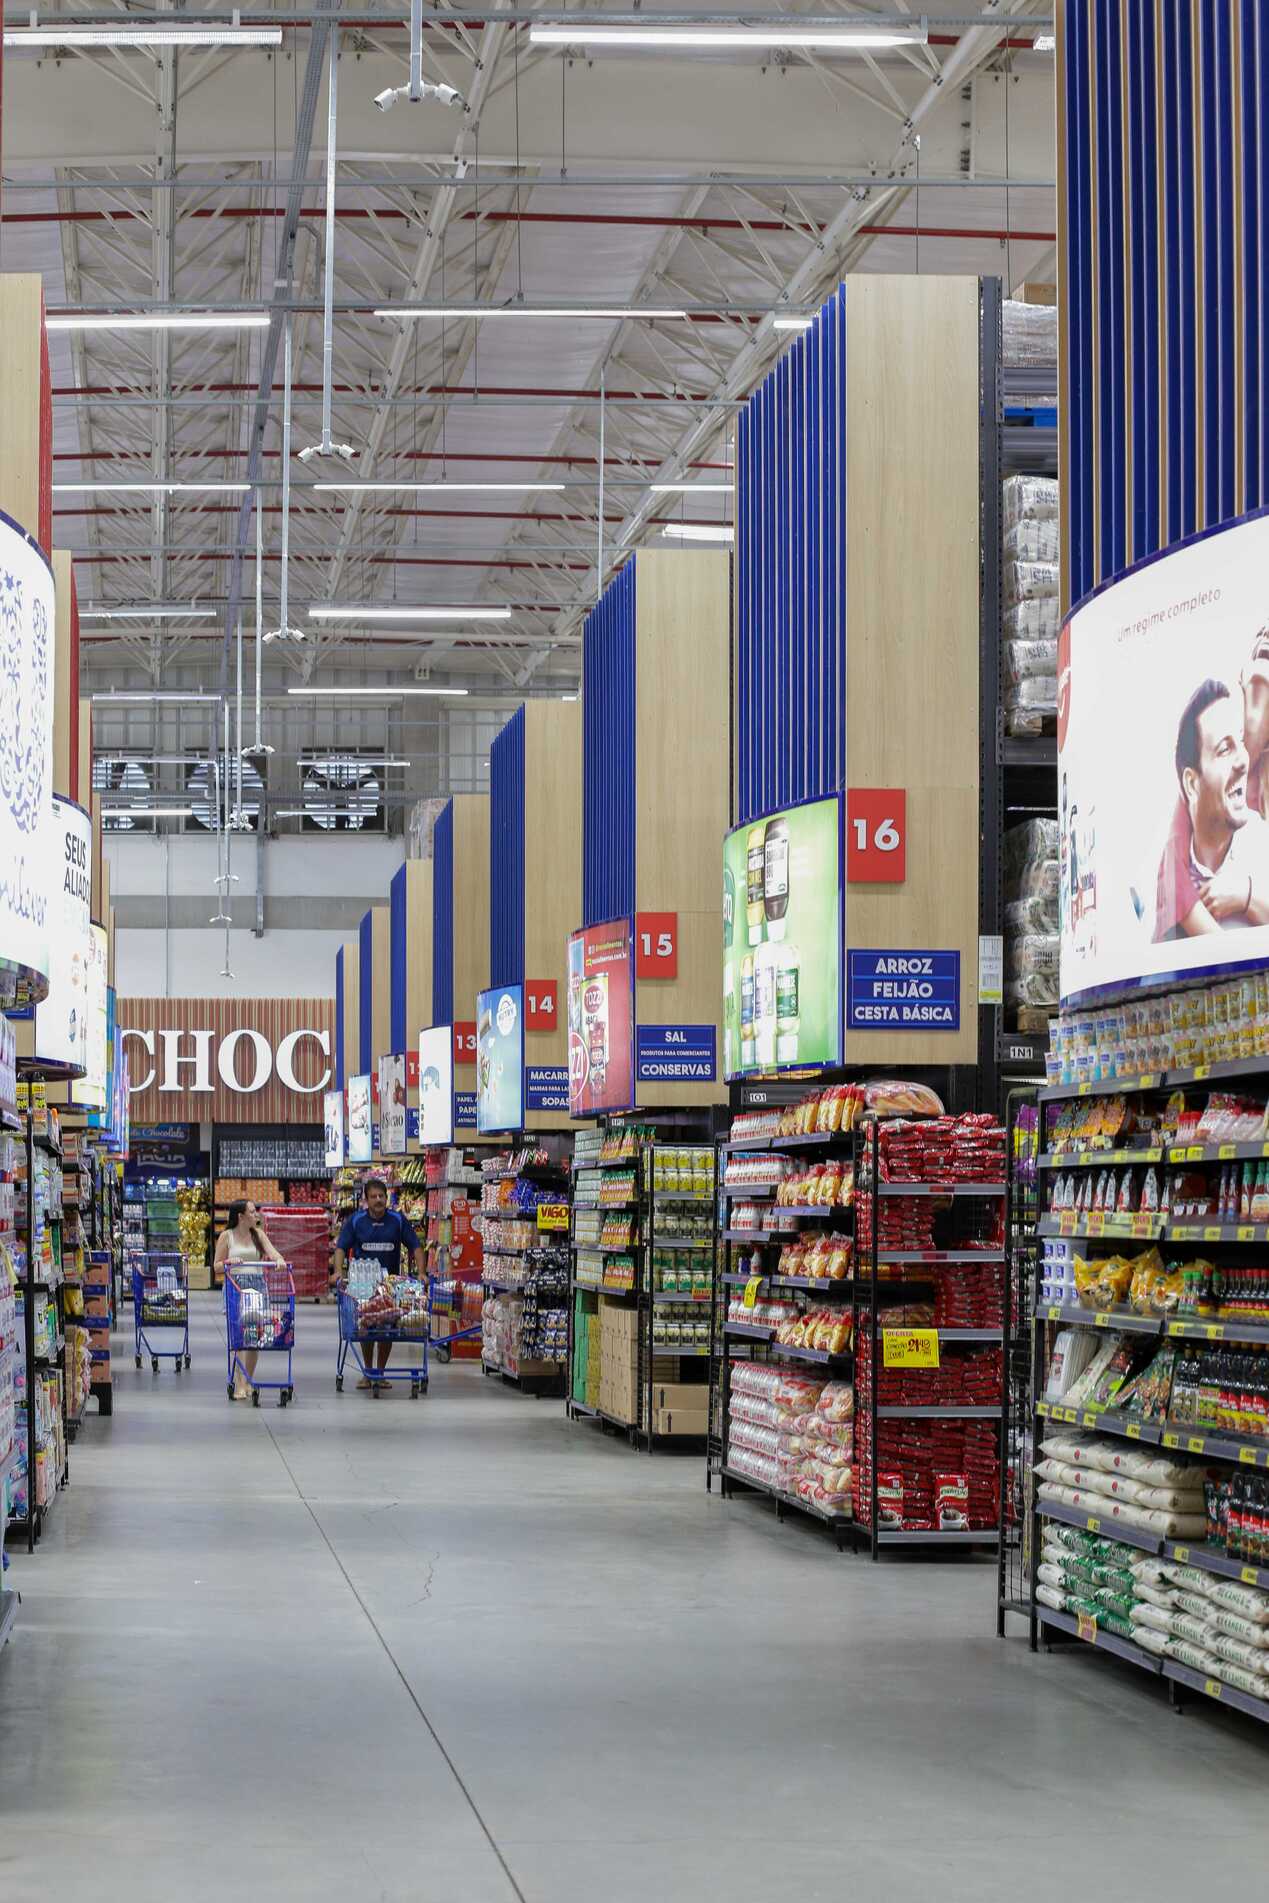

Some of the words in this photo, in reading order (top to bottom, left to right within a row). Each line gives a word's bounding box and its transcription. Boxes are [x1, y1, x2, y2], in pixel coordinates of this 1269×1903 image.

[1132, 610, 1166, 635] regime
[1167, 588, 1221, 618] completo
[853, 818, 900, 852] 16
[64, 832, 86, 870] SEUS
[640, 933, 673, 957] 15
[875, 958, 933, 974] ARROZ
[873, 979, 934, 998] FEIJÃO
[528, 995, 554, 1014] 14
[854, 1006, 899, 1021] CESTA
[903, 1003, 953, 1021] BÁSICA
[456, 1035, 477, 1050] 13
[665, 1031, 687, 1043] SAL
[121, 1029, 332, 1093] CHOC
[1011, 1047, 1033, 1059] 1N1
[641, 1064, 711, 1075] CONSERVAS
[542, 1097, 570, 1106] SOPAS
